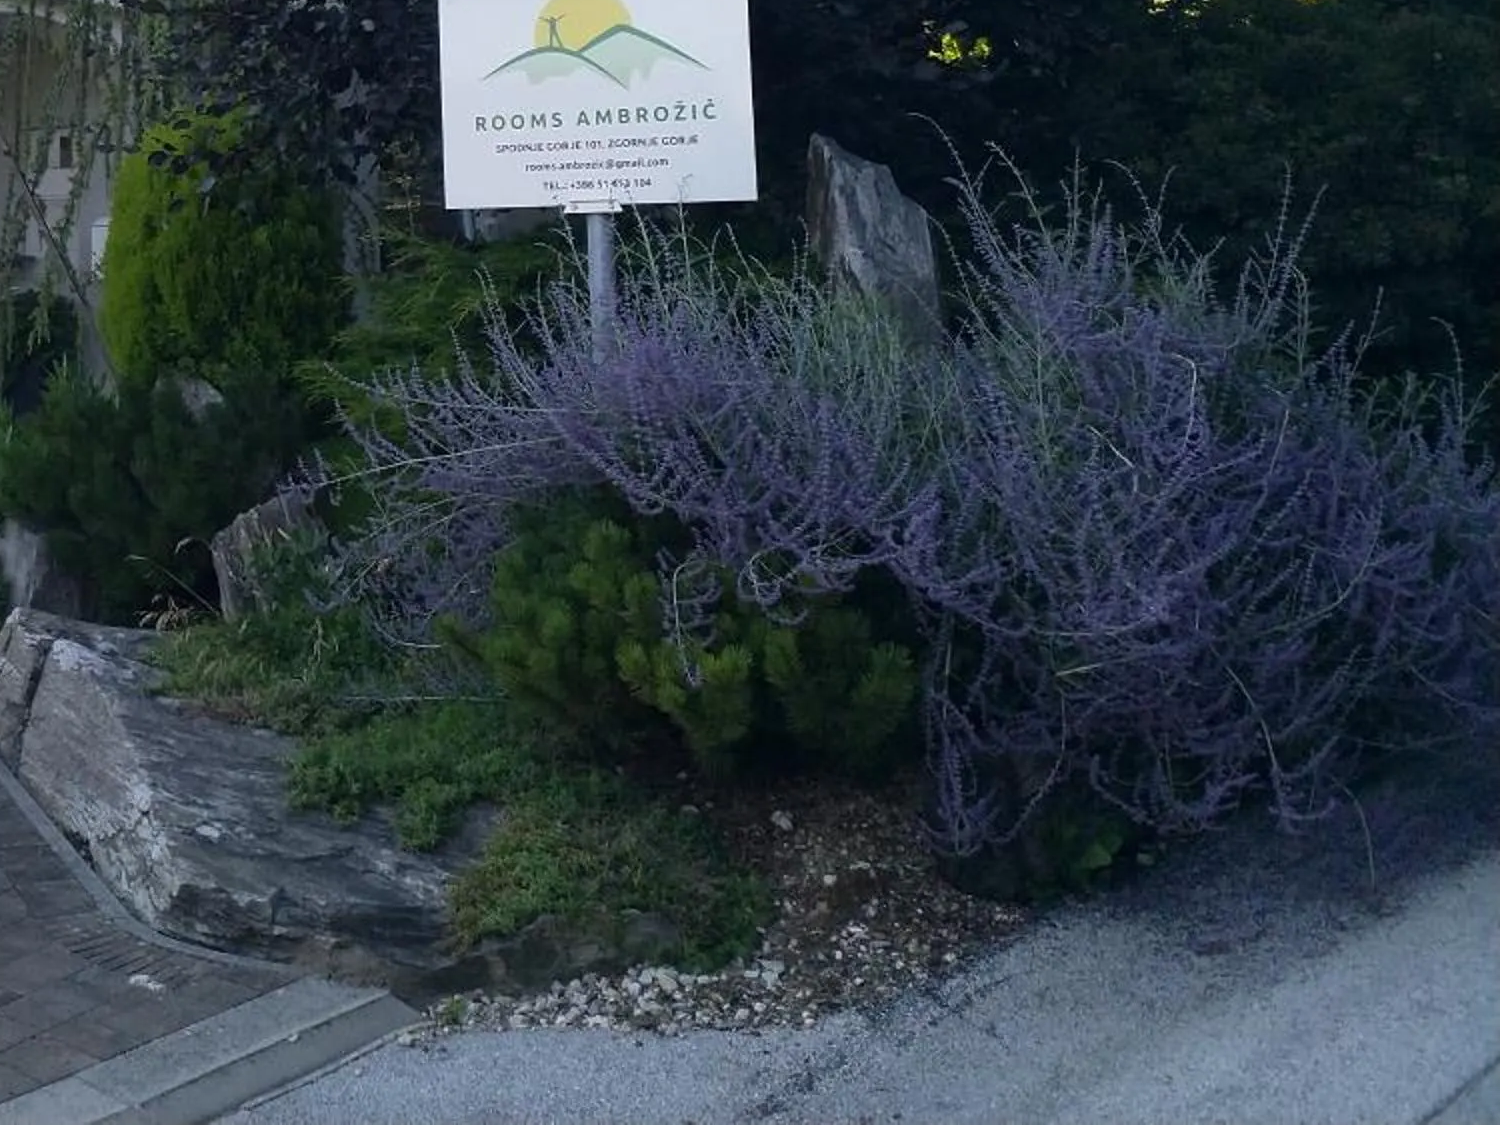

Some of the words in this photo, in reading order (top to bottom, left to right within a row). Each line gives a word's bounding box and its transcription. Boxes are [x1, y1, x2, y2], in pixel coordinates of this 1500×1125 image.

[475, 112, 563, 131] ROOMS
[576, 99, 718, 126] AMBROŽIČ
[546, 139, 582, 152] GORJE
[607, 136, 659, 149] ZGORNJE
[662, 133, 699, 146] GORJE
